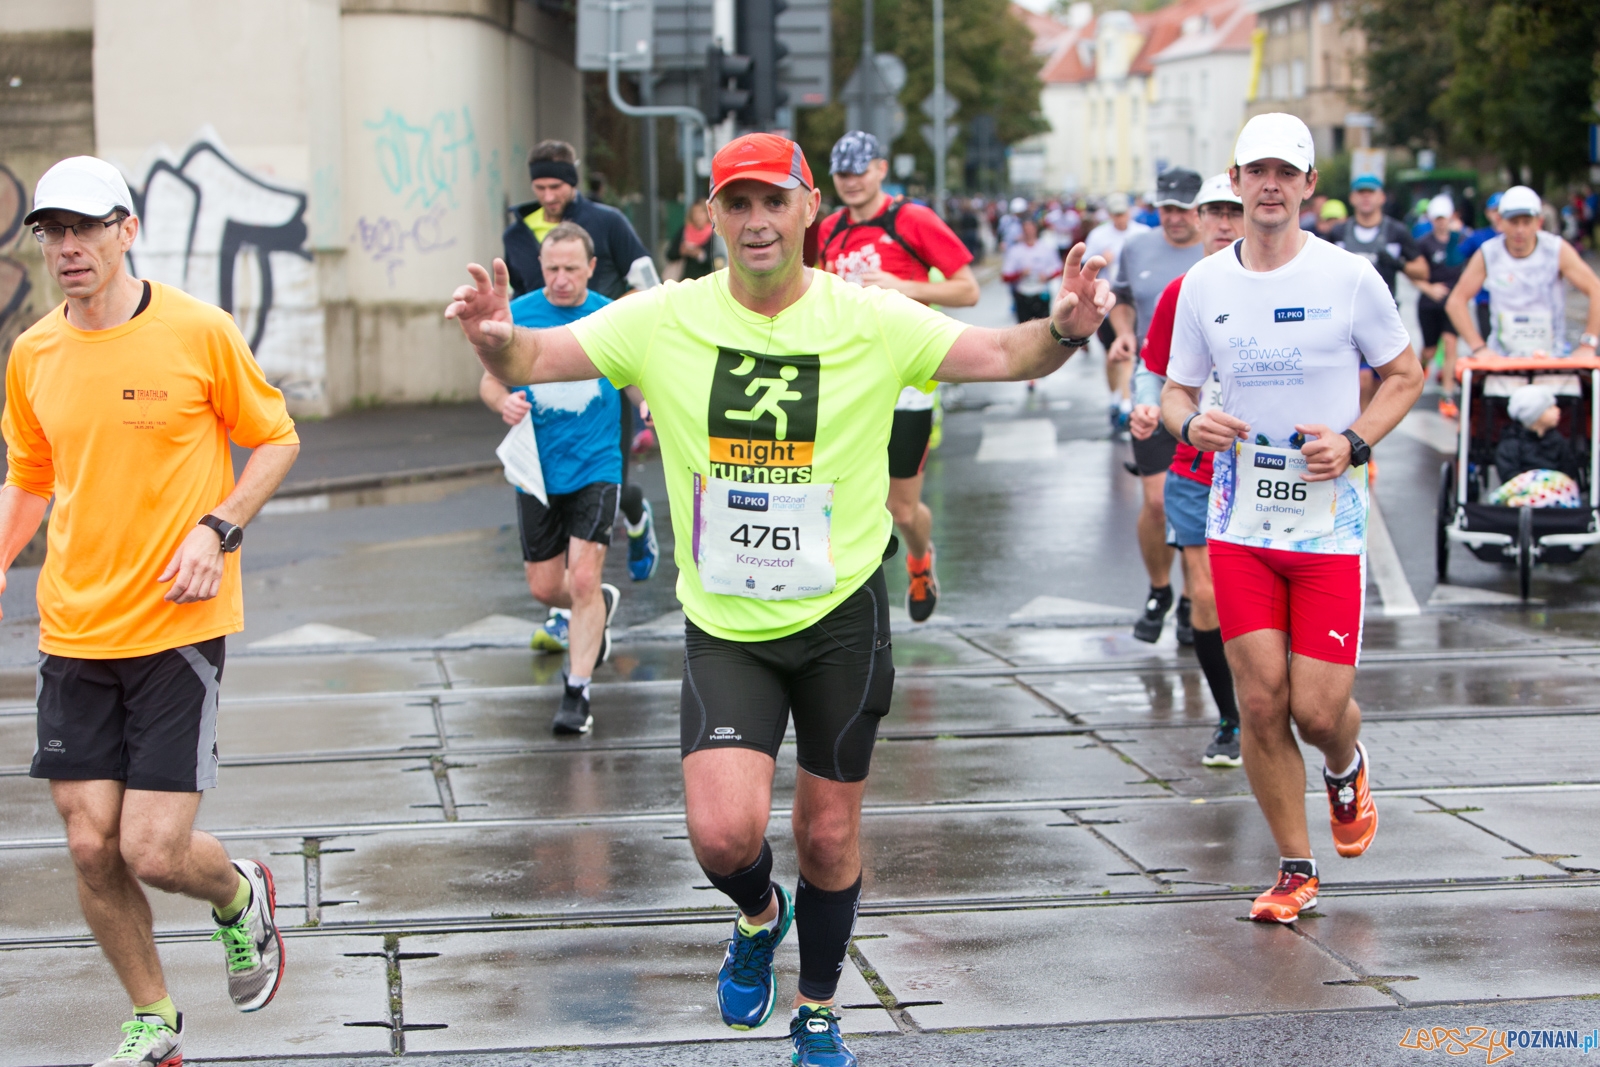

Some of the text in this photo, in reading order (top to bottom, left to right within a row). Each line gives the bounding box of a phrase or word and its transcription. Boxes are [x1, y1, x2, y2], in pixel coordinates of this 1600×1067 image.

[1214, 313, 1230, 324] 4F
[1287, 309, 1303, 318] PKO
[1229, 337, 1258, 348] SIŁA
[1239, 348, 1302, 360] ODWAGA
[1232, 359, 1303, 373] SZYBKOŚĆ
[1242, 379, 1285, 387] października
[1286, 377, 1304, 385] 2016
[137, 390, 167, 398] TRIATHLON
[730, 440, 795, 465] night
[1257, 456, 1283, 466] 17. PKO
[711, 463, 811, 483] runners
[1256, 479, 1307, 501] 886
[731, 495, 766, 506] 17. PKO
[730, 524, 800, 550] 4761
[736, 554, 795, 567] Krzysztof
[771, 584, 787, 592] 4F
